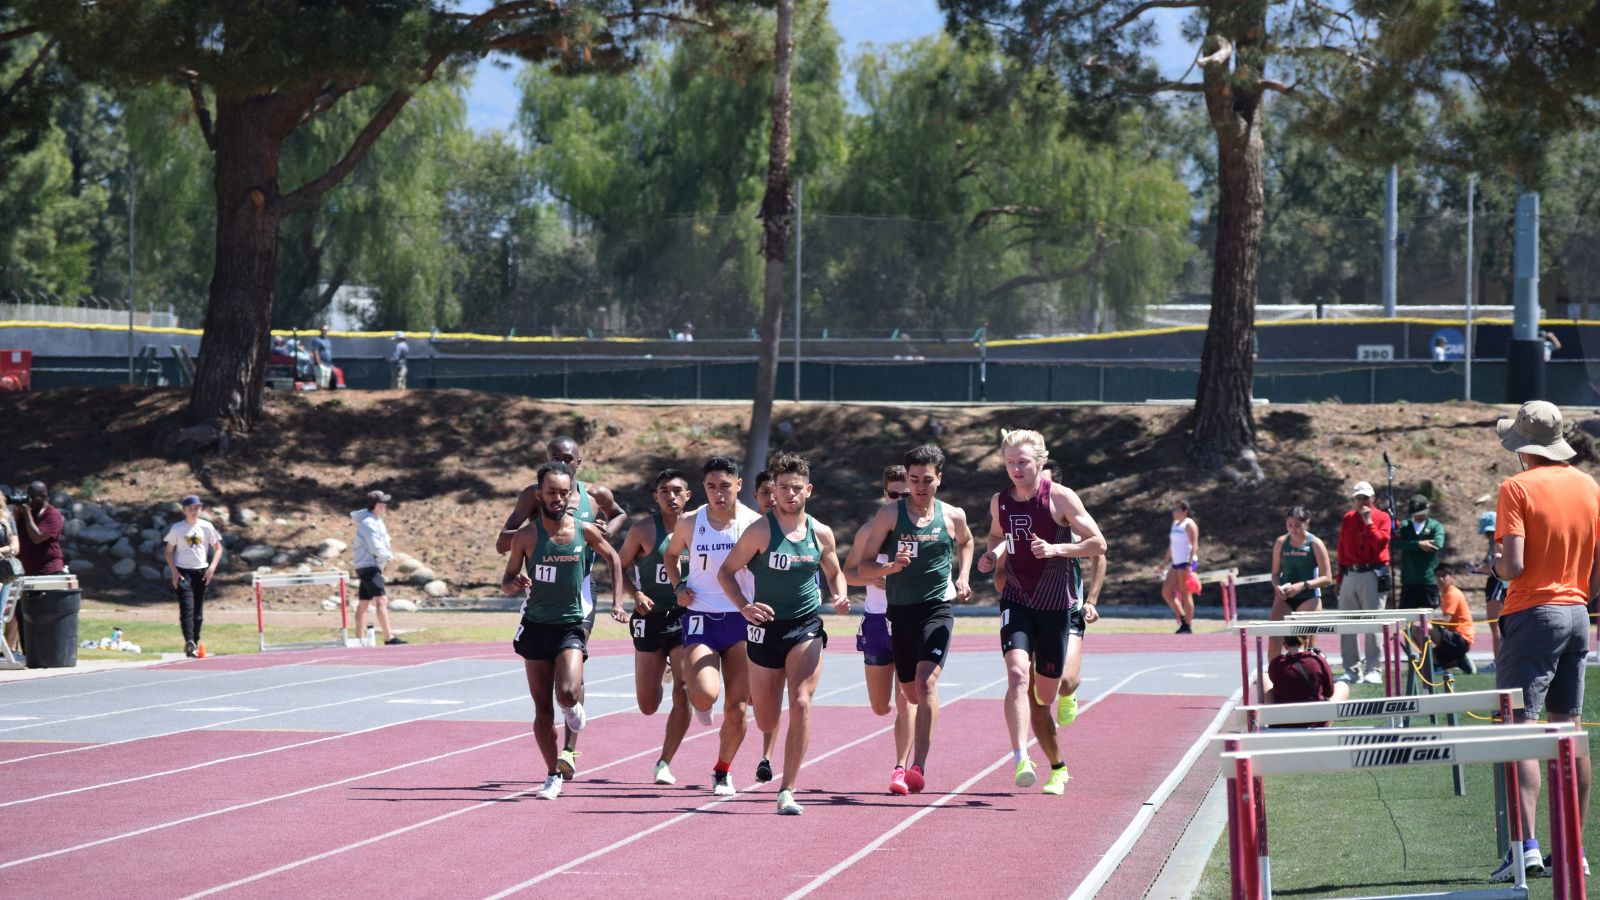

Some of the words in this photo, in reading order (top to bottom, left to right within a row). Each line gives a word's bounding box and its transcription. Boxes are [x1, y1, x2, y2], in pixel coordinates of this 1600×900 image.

[1009, 514, 1034, 541] R
[696, 544, 709, 552] CAL
[698, 553, 708, 571] 7
[773, 553, 788, 569] 10
[538, 566, 552, 581] 11
[659, 565, 668, 583] 6
[691, 617, 700, 634] 7
[749, 626, 761, 642] 10
[1385, 701, 1416, 712] GILL
[1412, 747, 1451, 761] GILL
